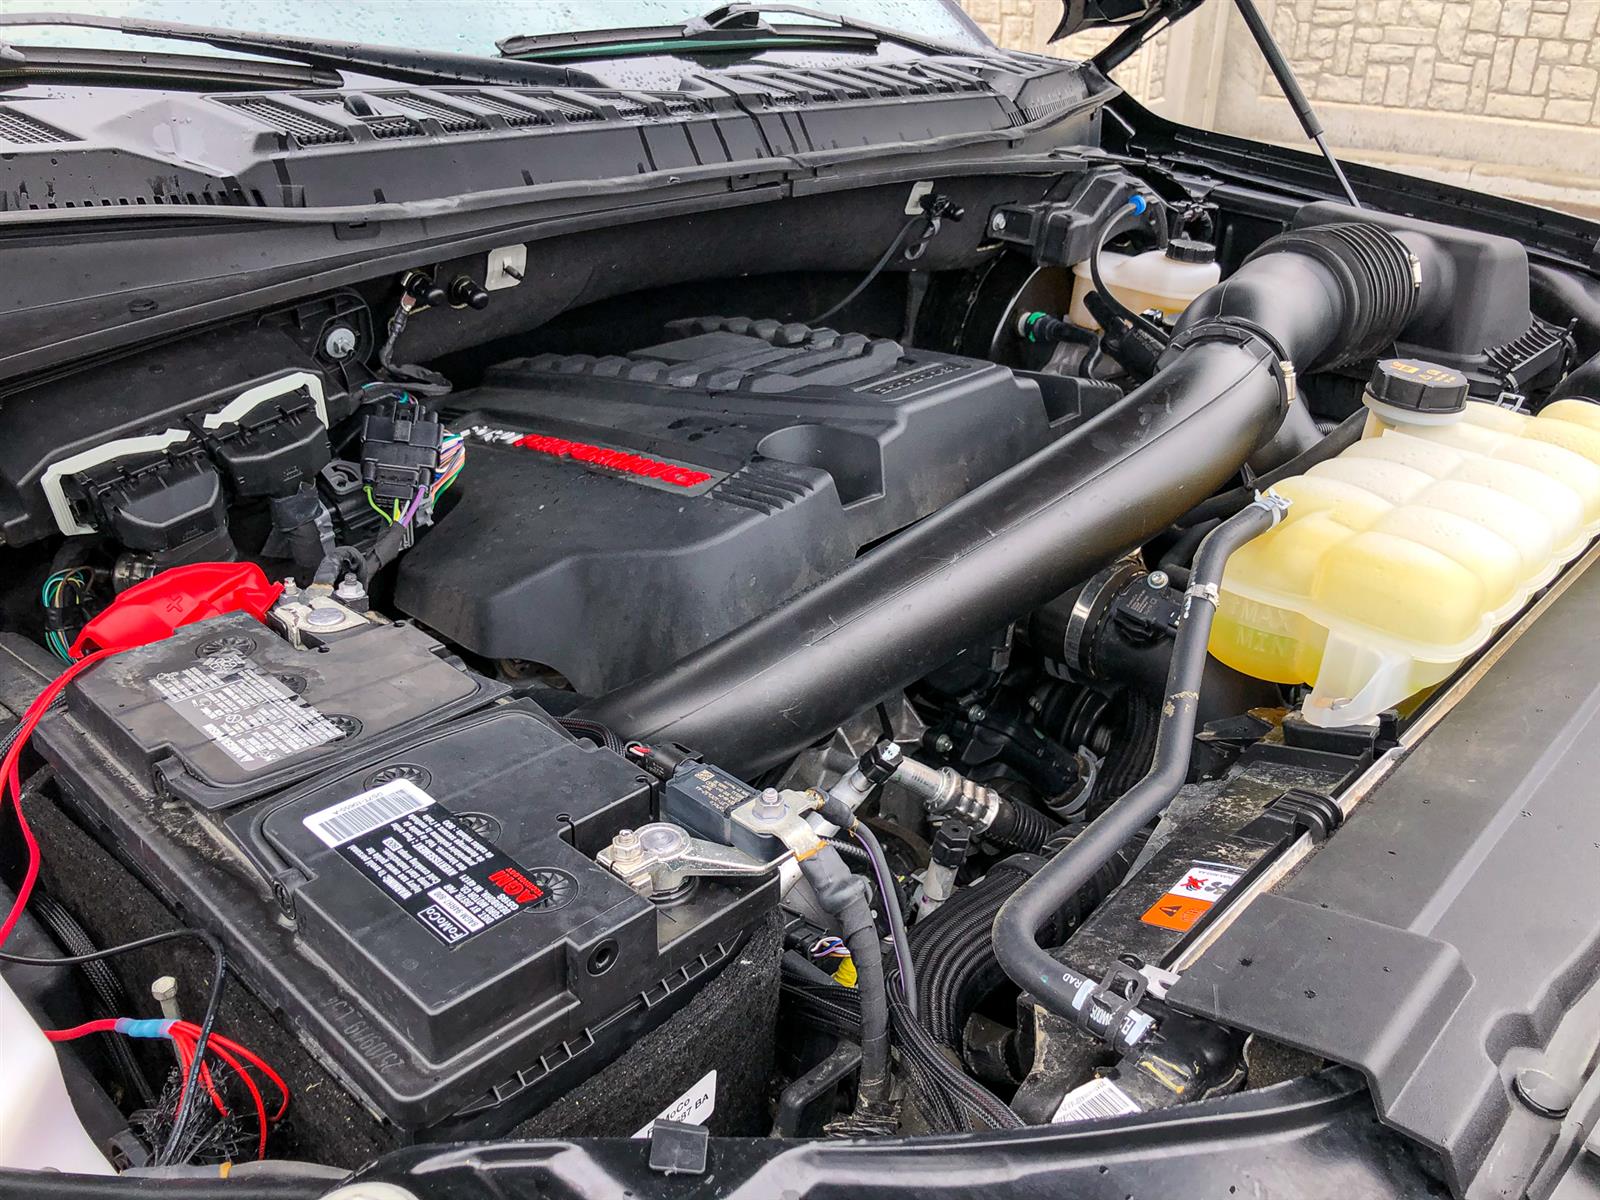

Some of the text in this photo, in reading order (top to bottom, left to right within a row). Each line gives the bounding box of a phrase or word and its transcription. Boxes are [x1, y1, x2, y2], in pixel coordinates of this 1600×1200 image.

[488, 869, 538, 904] AGM
[426, 907, 464, 940] FoMoCo
[1062, 973, 1083, 989] RAD
[695, 1093, 709, 1110] BA
